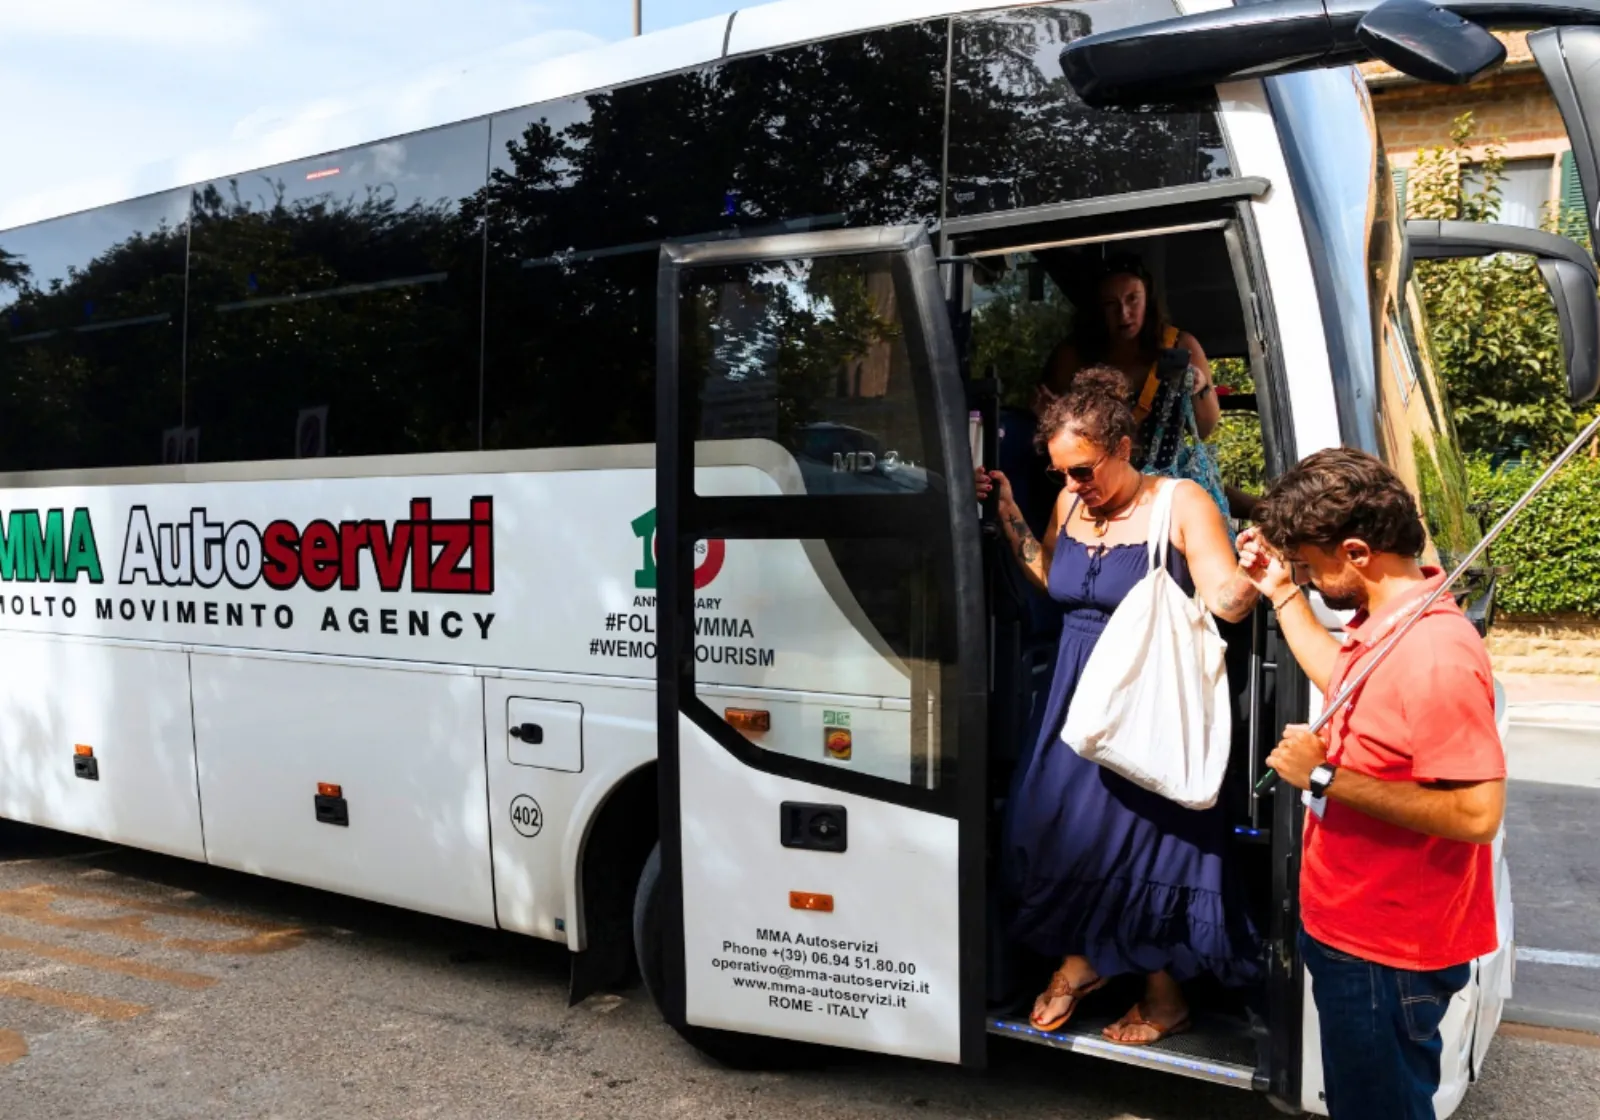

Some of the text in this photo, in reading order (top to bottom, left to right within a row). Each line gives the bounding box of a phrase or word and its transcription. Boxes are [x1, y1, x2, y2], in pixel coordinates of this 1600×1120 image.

[832, 450, 876, 473] MD
[0, 495, 494, 594] MMA Autoservizi
[0, 594, 496, 640] OLTO MOVIMENTO AGENCY
[589, 638, 775, 667] #WEMOOURISM
[512, 804, 540, 828] 402
[756, 928, 879, 953] MMA Autoservizi
[722, 940, 917, 975] Phone +(39) 06.94 51.80.00
[711, 958, 930, 994] operativo@mma-autoservizi.it
[732, 977, 907, 1009] www.mma-autoservizi.it
[768, 995, 814, 1012] ROME
[827, 1003, 869, 1020] ITALY
